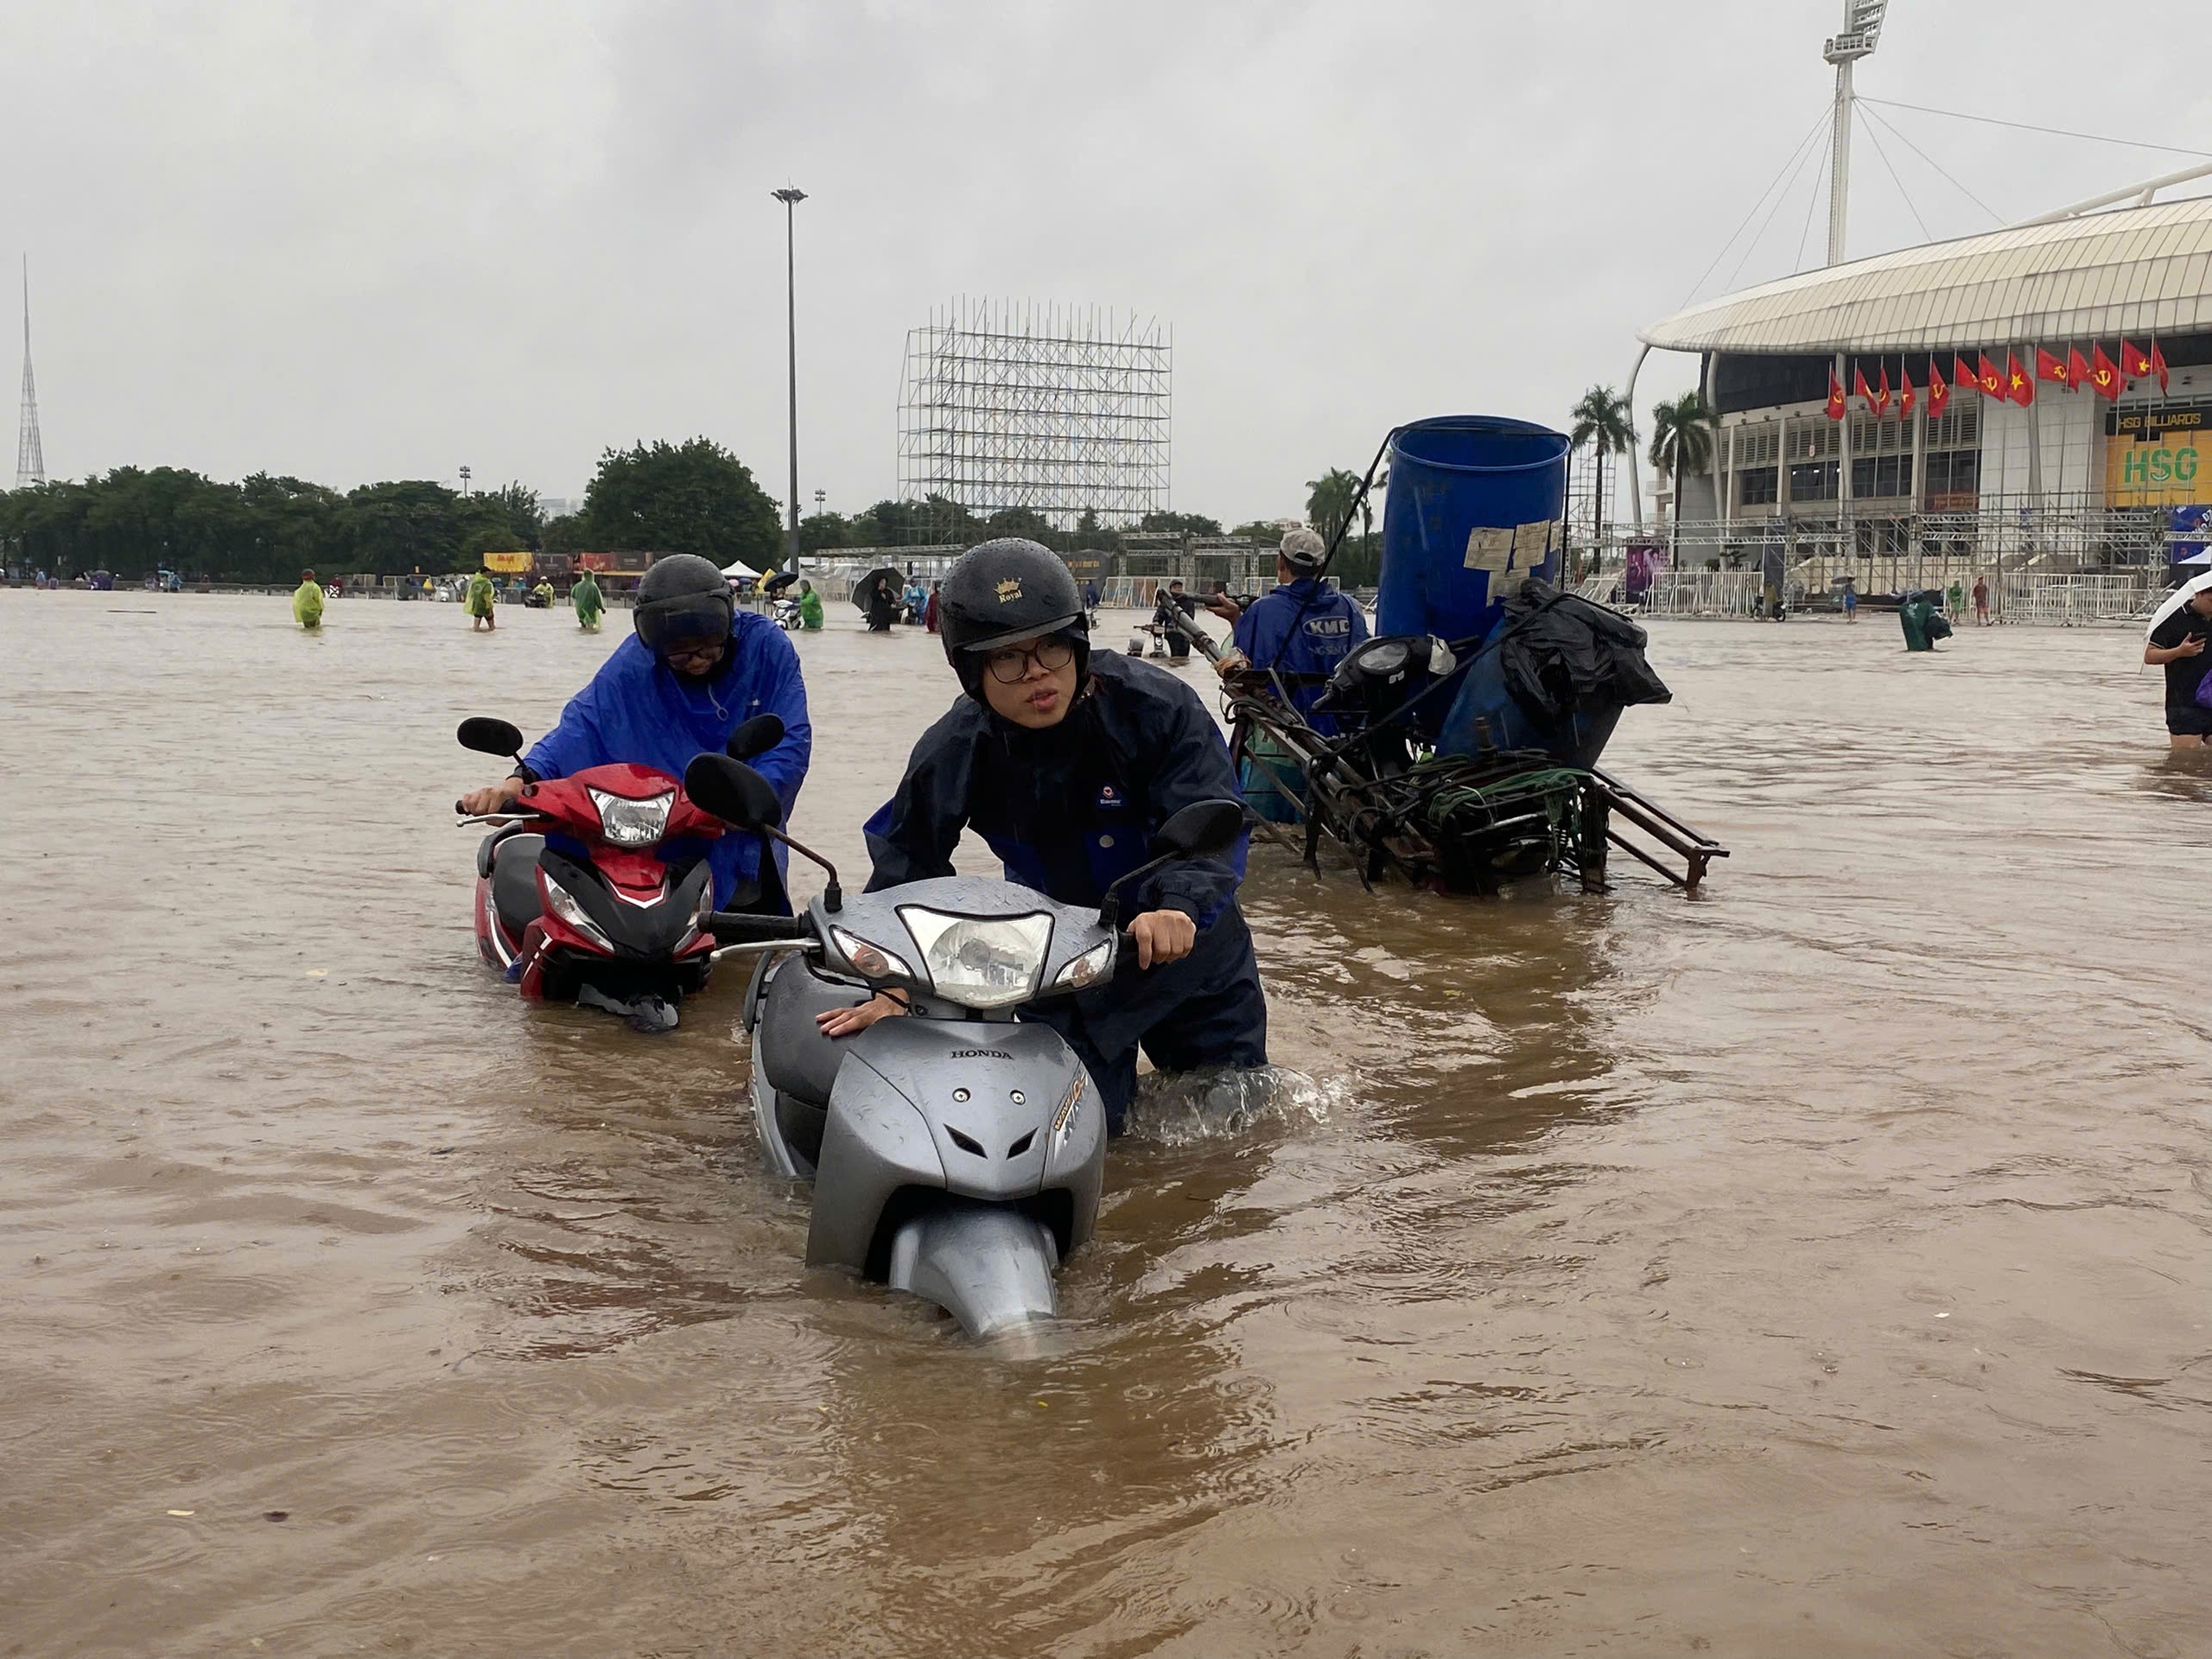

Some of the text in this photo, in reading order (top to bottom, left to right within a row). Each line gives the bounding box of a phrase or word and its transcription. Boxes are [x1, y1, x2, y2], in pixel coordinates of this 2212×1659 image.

[2119, 413, 2202, 429] HSG BILLIARDS
[2124, 447, 2199, 483] HSG
[999, 589, 1023, 603] Royal
[950, 1049, 1014, 1060] HONDA
